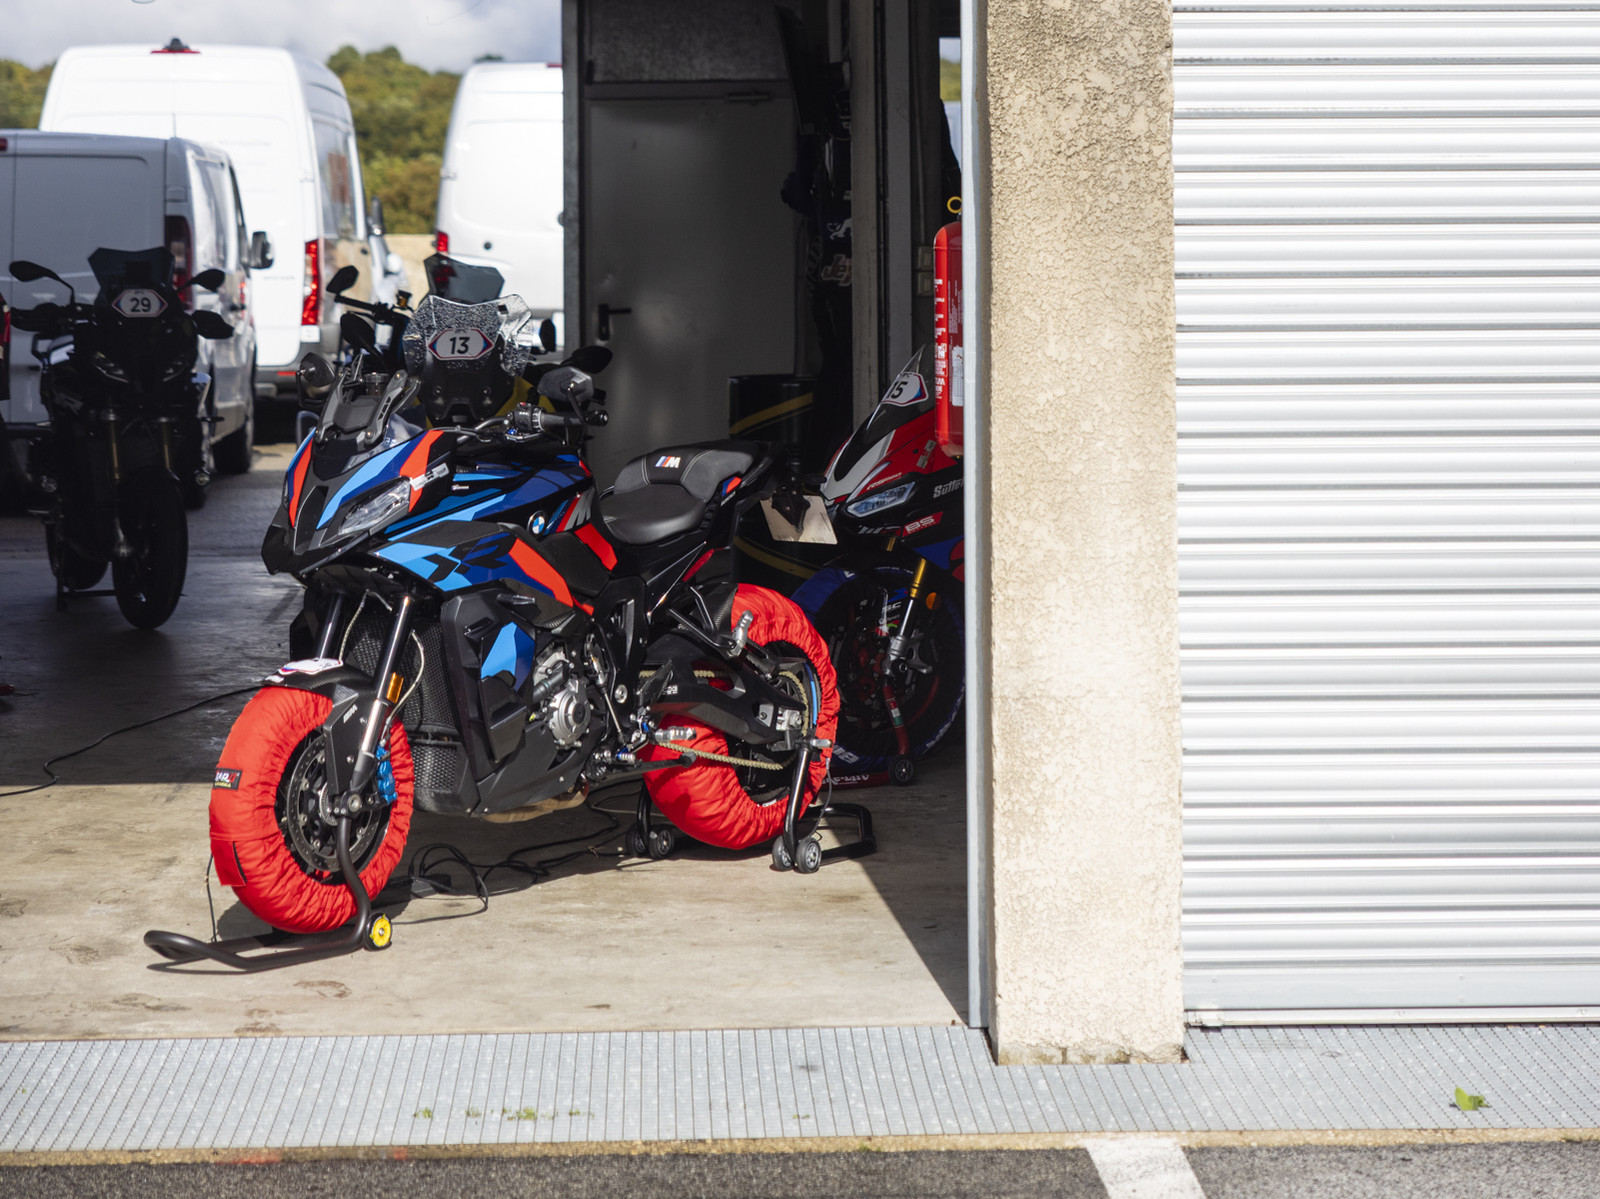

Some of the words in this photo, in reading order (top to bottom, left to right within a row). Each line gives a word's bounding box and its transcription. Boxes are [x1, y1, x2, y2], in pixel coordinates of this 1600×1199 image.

[130, 297, 151, 313] 29
[449, 336, 471, 355] 13
[886, 381, 908, 399] 15
